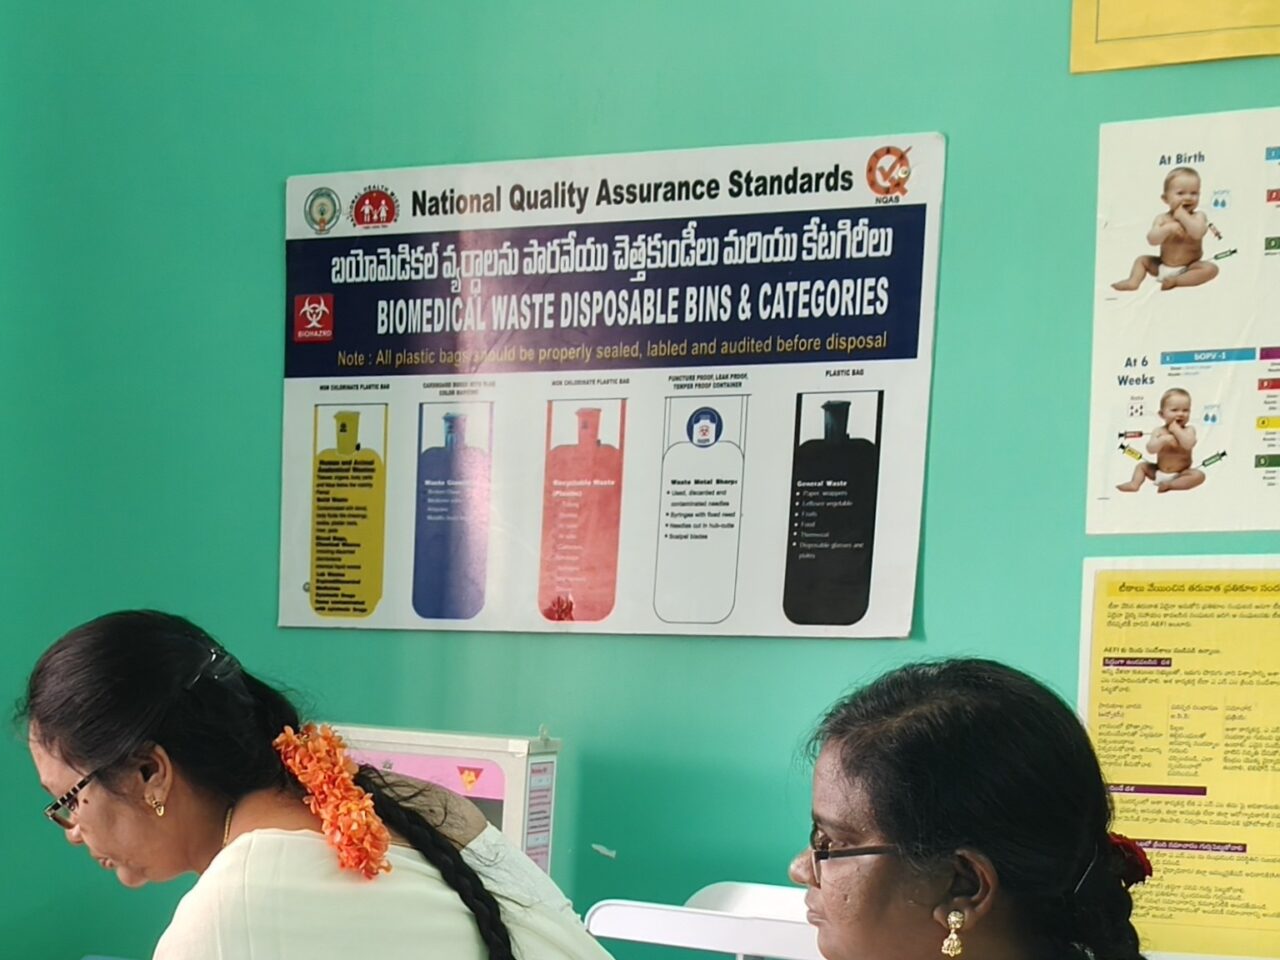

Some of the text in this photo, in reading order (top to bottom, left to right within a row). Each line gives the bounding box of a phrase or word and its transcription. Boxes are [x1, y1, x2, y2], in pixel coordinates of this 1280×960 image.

[1175, 151, 1206, 164] Birth
[411, 163, 854, 218] National Quality Assurance Standards
[874, 195, 900, 205] NQAS
[723, 226, 798, 266] మరియు
[376, 275, 889, 336] BIOMEDICAL WASTE DISPOSABLE BINS & CATEGORIES
[337, 349, 365, 367] Note
[375, 348, 393, 366] All
[395, 346, 436, 368] plastic
[438, 345, 469, 367] bags
[519, 344, 535, 362] be
[538, 342, 592, 367] properly
[595, 340, 643, 360] sealed,
[646, 338, 688, 357] labled
[690, 337, 717, 355] and
[720, 335, 772, 354] audited
[776, 334, 822, 352] before
[825, 331, 888, 353] disposal
[1140, 356, 1149, 367] 6
[1117, 374, 1155, 386] Weeks
